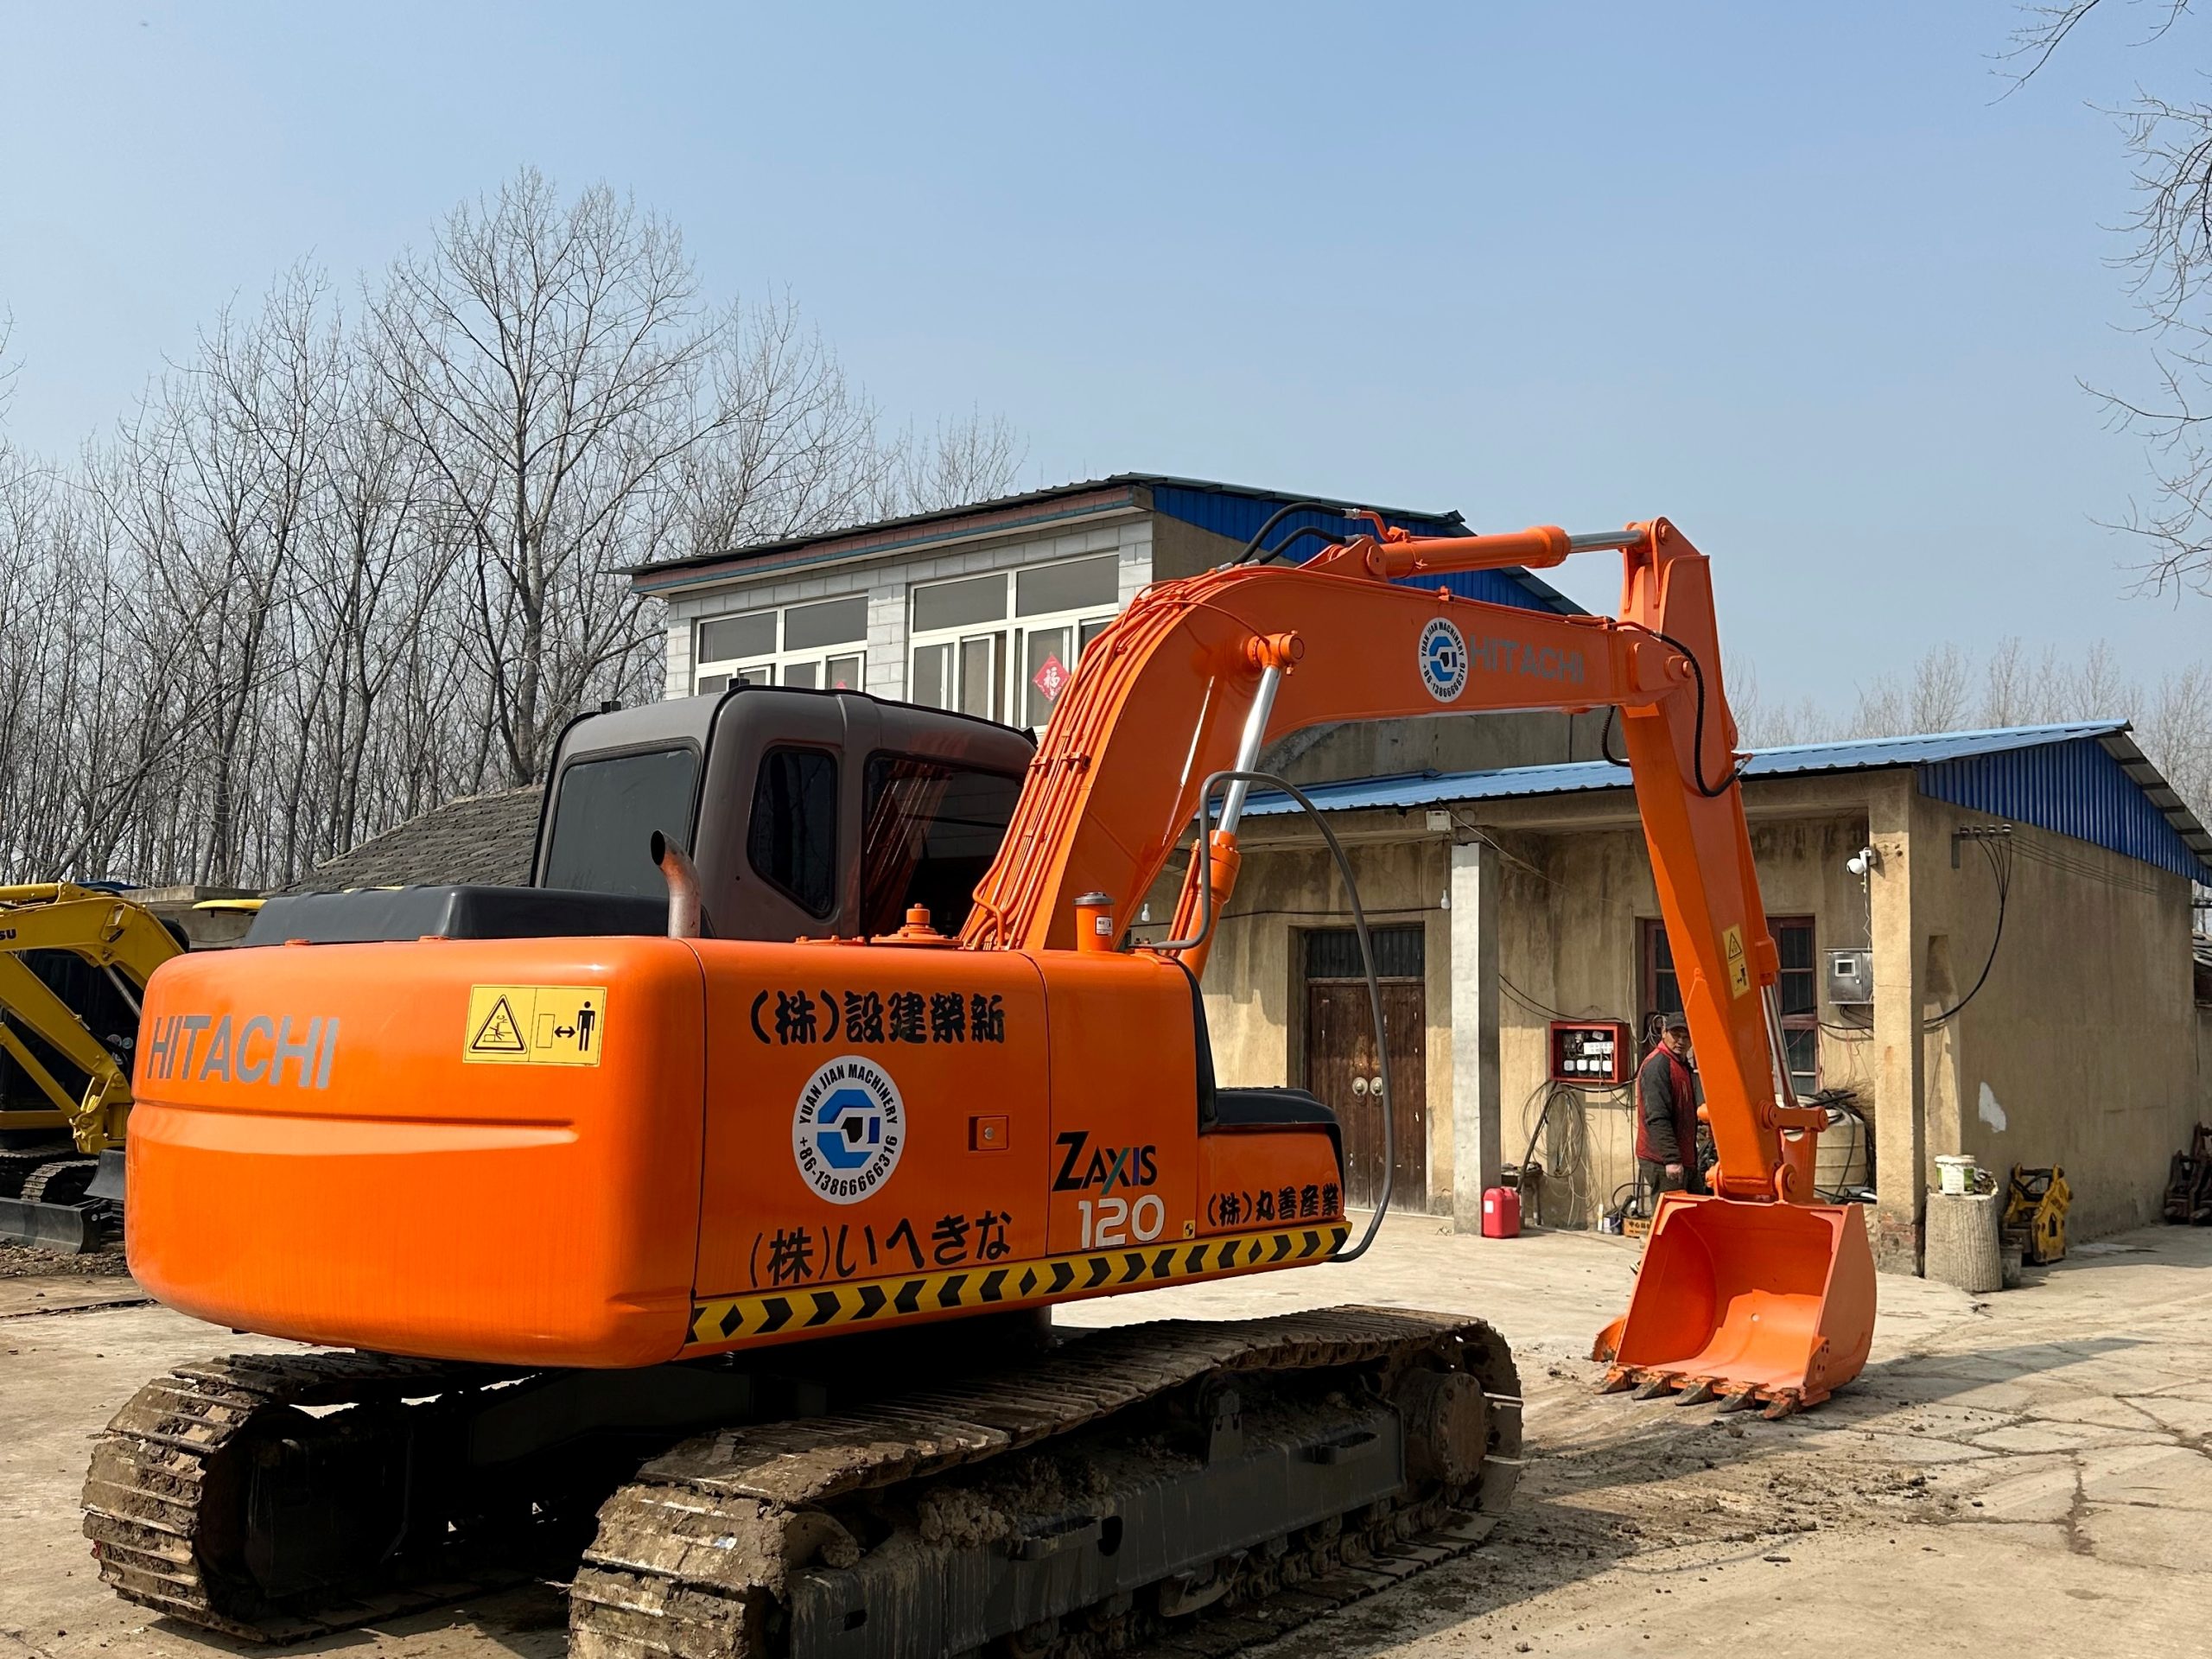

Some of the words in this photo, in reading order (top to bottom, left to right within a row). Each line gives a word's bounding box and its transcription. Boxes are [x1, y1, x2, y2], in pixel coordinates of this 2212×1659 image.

[1043, 666, 1061, 690] 福
[1470, 634, 1584, 683] HITACHI
[147, 1015, 340, 1088] HITACHI
[799, 1084, 822, 1124] YUAN
[819, 1065, 845, 1090] JIAN
[849, 1064, 898, 1124] MACHINERY
[1052, 1131, 1158, 1196] ZAXIS
[1078, 1194, 1165, 1249] 120
